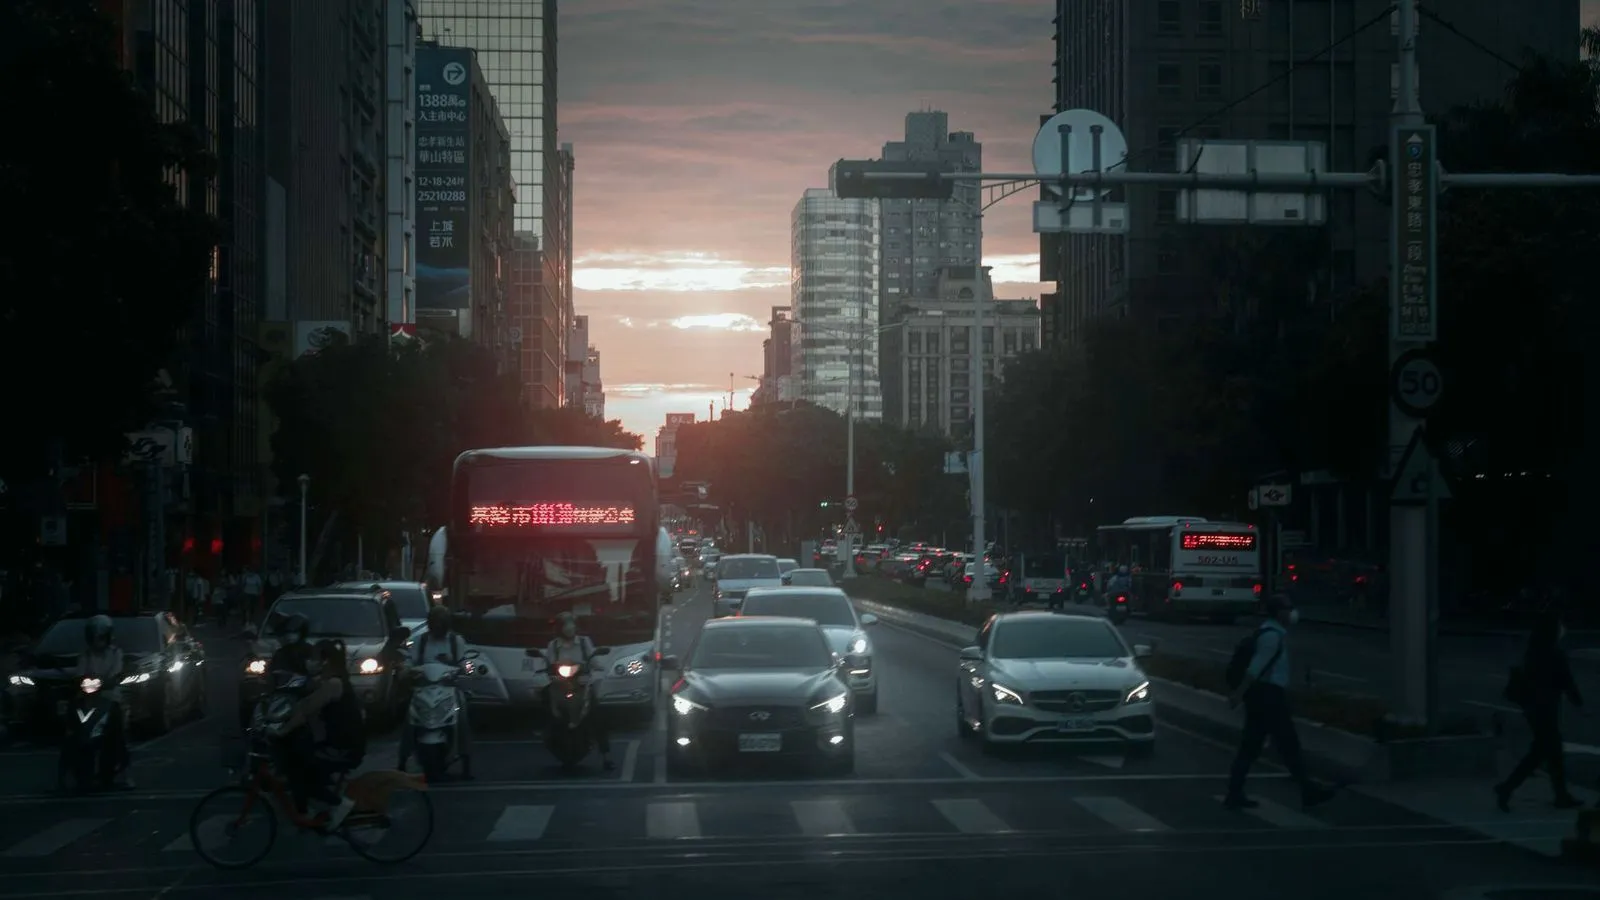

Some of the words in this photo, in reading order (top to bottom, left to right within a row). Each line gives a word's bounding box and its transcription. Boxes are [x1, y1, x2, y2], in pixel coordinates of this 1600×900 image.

[419, 110, 466, 121] 入主市中心
[418, 191, 466, 201] 25210288
[1403, 371, 1438, 395] 50
